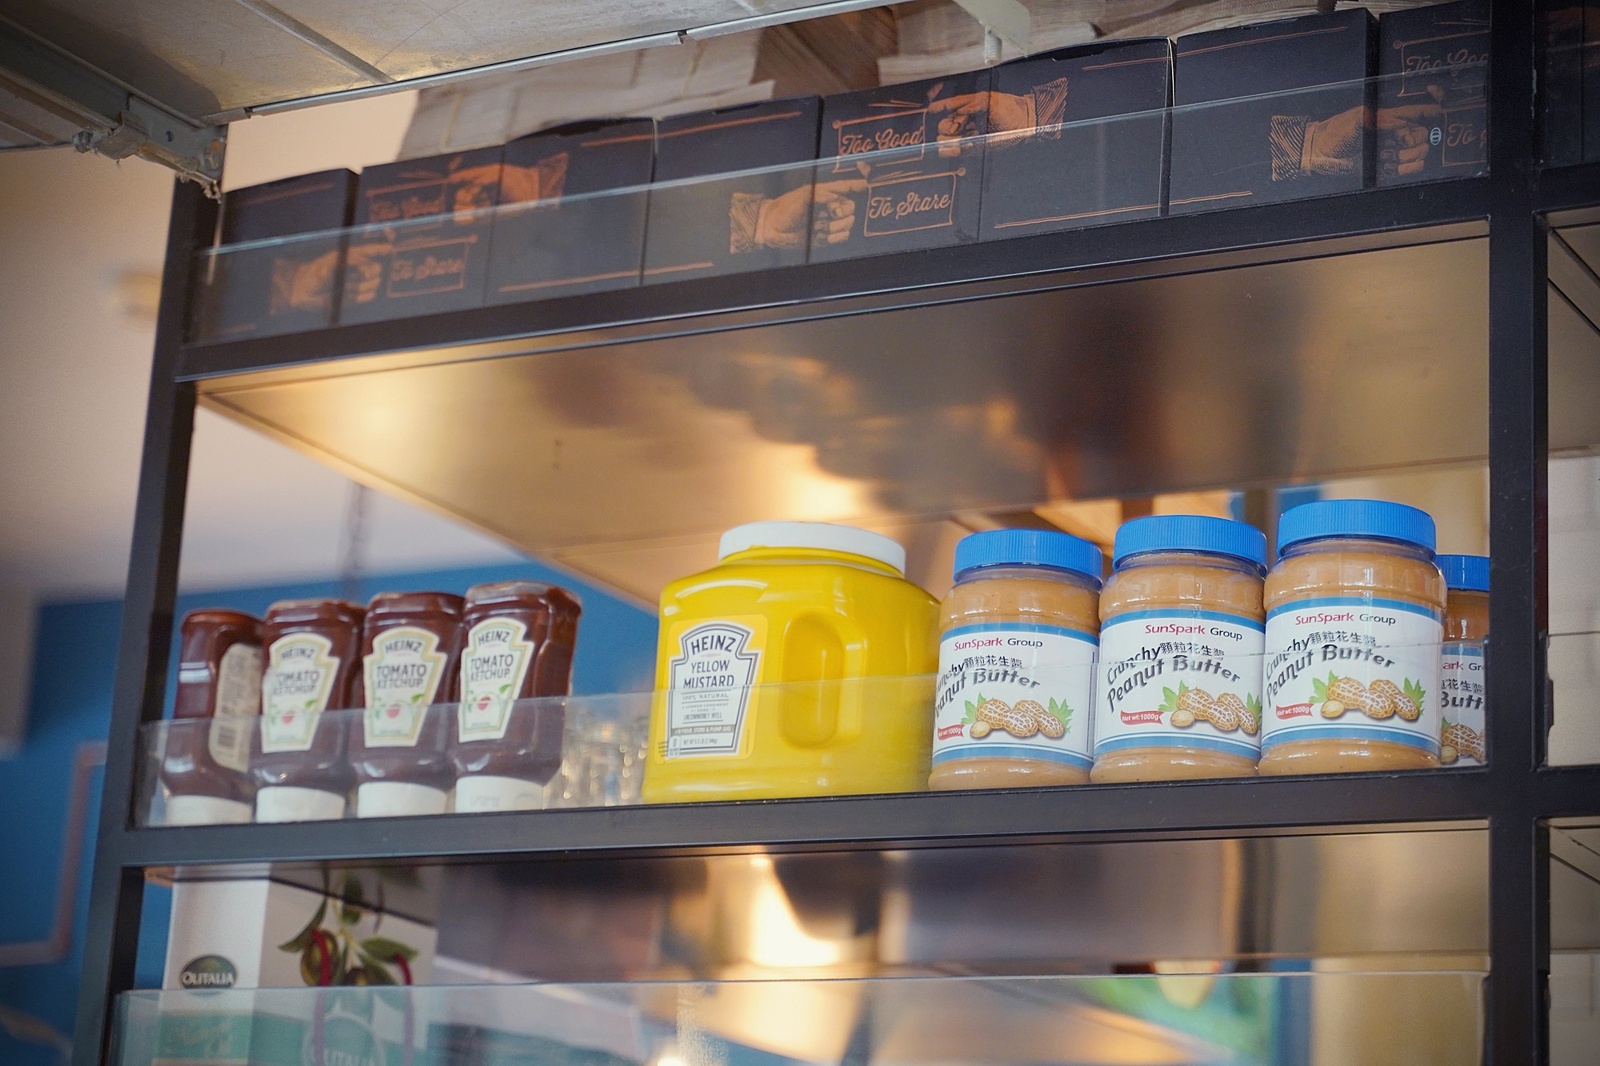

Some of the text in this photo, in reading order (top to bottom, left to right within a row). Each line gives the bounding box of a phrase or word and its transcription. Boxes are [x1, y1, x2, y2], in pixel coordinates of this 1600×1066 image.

[1446, 49, 1489, 75] Goo
[840, 127, 926, 156] Too Good
[1446, 123, 1476, 148] To
[869, 192, 950, 220] To Share
[1295, 613, 1396, 626] SunSpark Group
[478, 630, 511, 646] HEINZ
[1144, 624, 1243, 641] SunSpark Group
[385, 640, 423, 654] HEINZ
[691, 635, 737, 655] HEINZ
[954, 637, 1043, 651] SunSpark Group
[470, 653, 515, 671] TOMATO
[690, 659, 731, 674] YELLOW
[1107, 646, 1161, 685] Crunchy
[376, 664, 427, 679] TOMATO
[470, 668, 511, 682] KETCHUP
[973, 667, 1041, 689] Butter
[1266, 644, 1396, 709] Peanut Butter
[376, 677, 424, 690] KETCHUP
[683, 674, 735, 690] MUSTARD
[1107, 654, 1241, 714] Peanut Butter
[699, 692, 729, 700] NATURAL
[181, 970, 235, 985] OLITALIA
